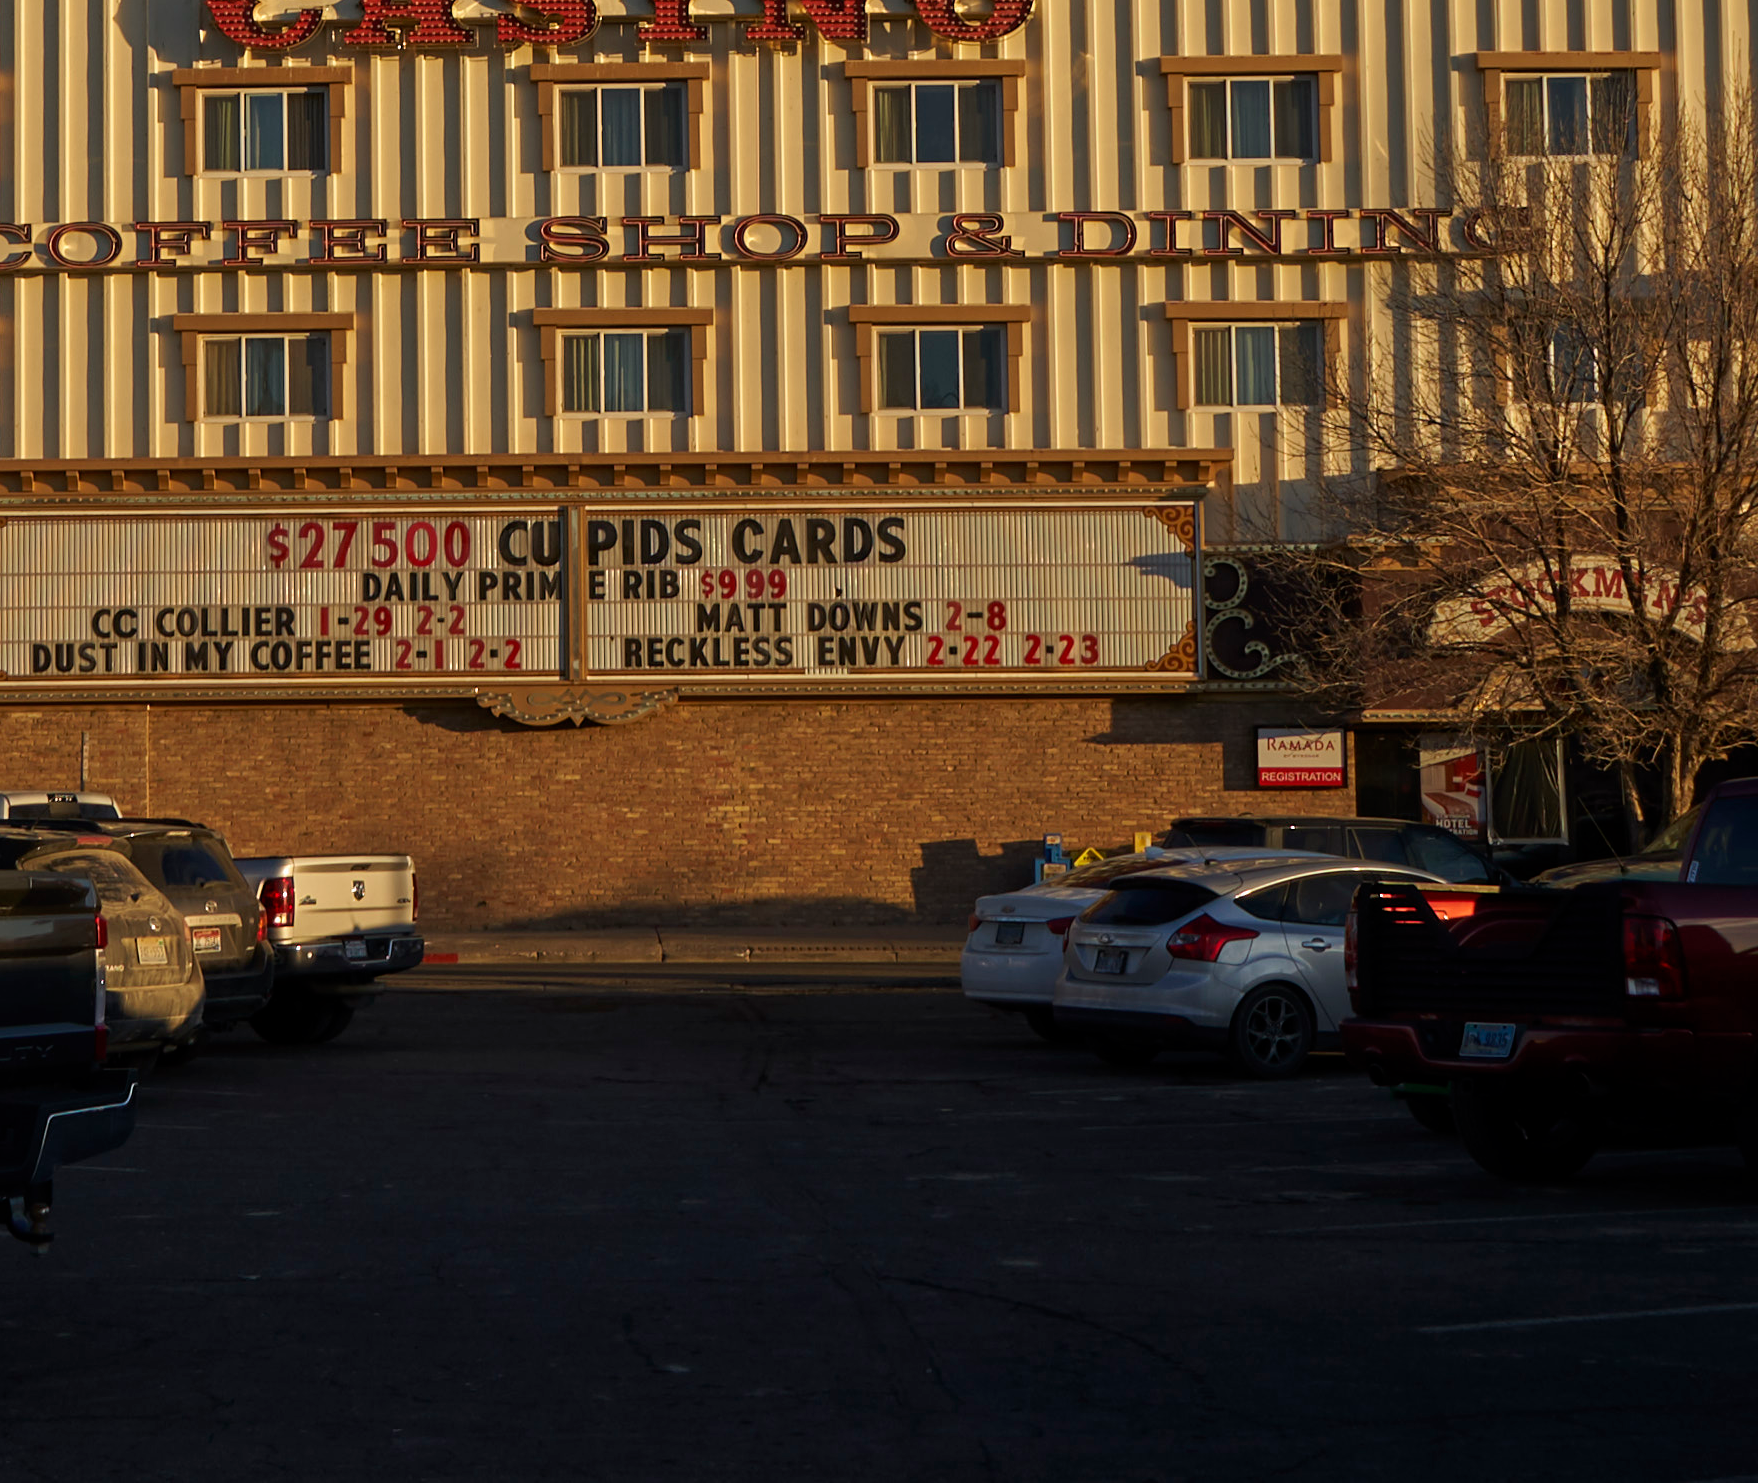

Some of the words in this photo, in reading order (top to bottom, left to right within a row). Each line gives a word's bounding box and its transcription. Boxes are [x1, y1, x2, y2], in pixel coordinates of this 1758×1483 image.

[539, 211, 900, 263] SHOP
[944, 212, 1025, 258] &
[1057, 207, 1533, 256] DINING
[731, 516, 907, 565] CARDS
[362, 570, 465, 603] DAILY
[622, 568, 681, 599] RIB
[92, 608, 138, 639] CC
[156, 606, 295, 638] COLLIER
[416, 604, 466, 636] 2-2
[696, 602, 788, 633] MATT
[807, 601, 924, 633] DOWNS
[944, 600, 1007, 631] 2-8
[32, 642, 119, 674] DUST
[138, 641, 169, 673] IN
[184, 641, 234, 672] MY
[250, 640, 372, 672] COFFEE
[394, 639, 445, 670] 2-1
[468, 638, 522, 670] 2-2
[623, 635, 794, 668] RECKLESS
[817, 635, 906, 667] ENVY
[1267, 737, 1335, 751] RAMADA
[1261, 771, 1342, 783] REGISTRATION
[1435, 818, 1472, 829] HOTEL
